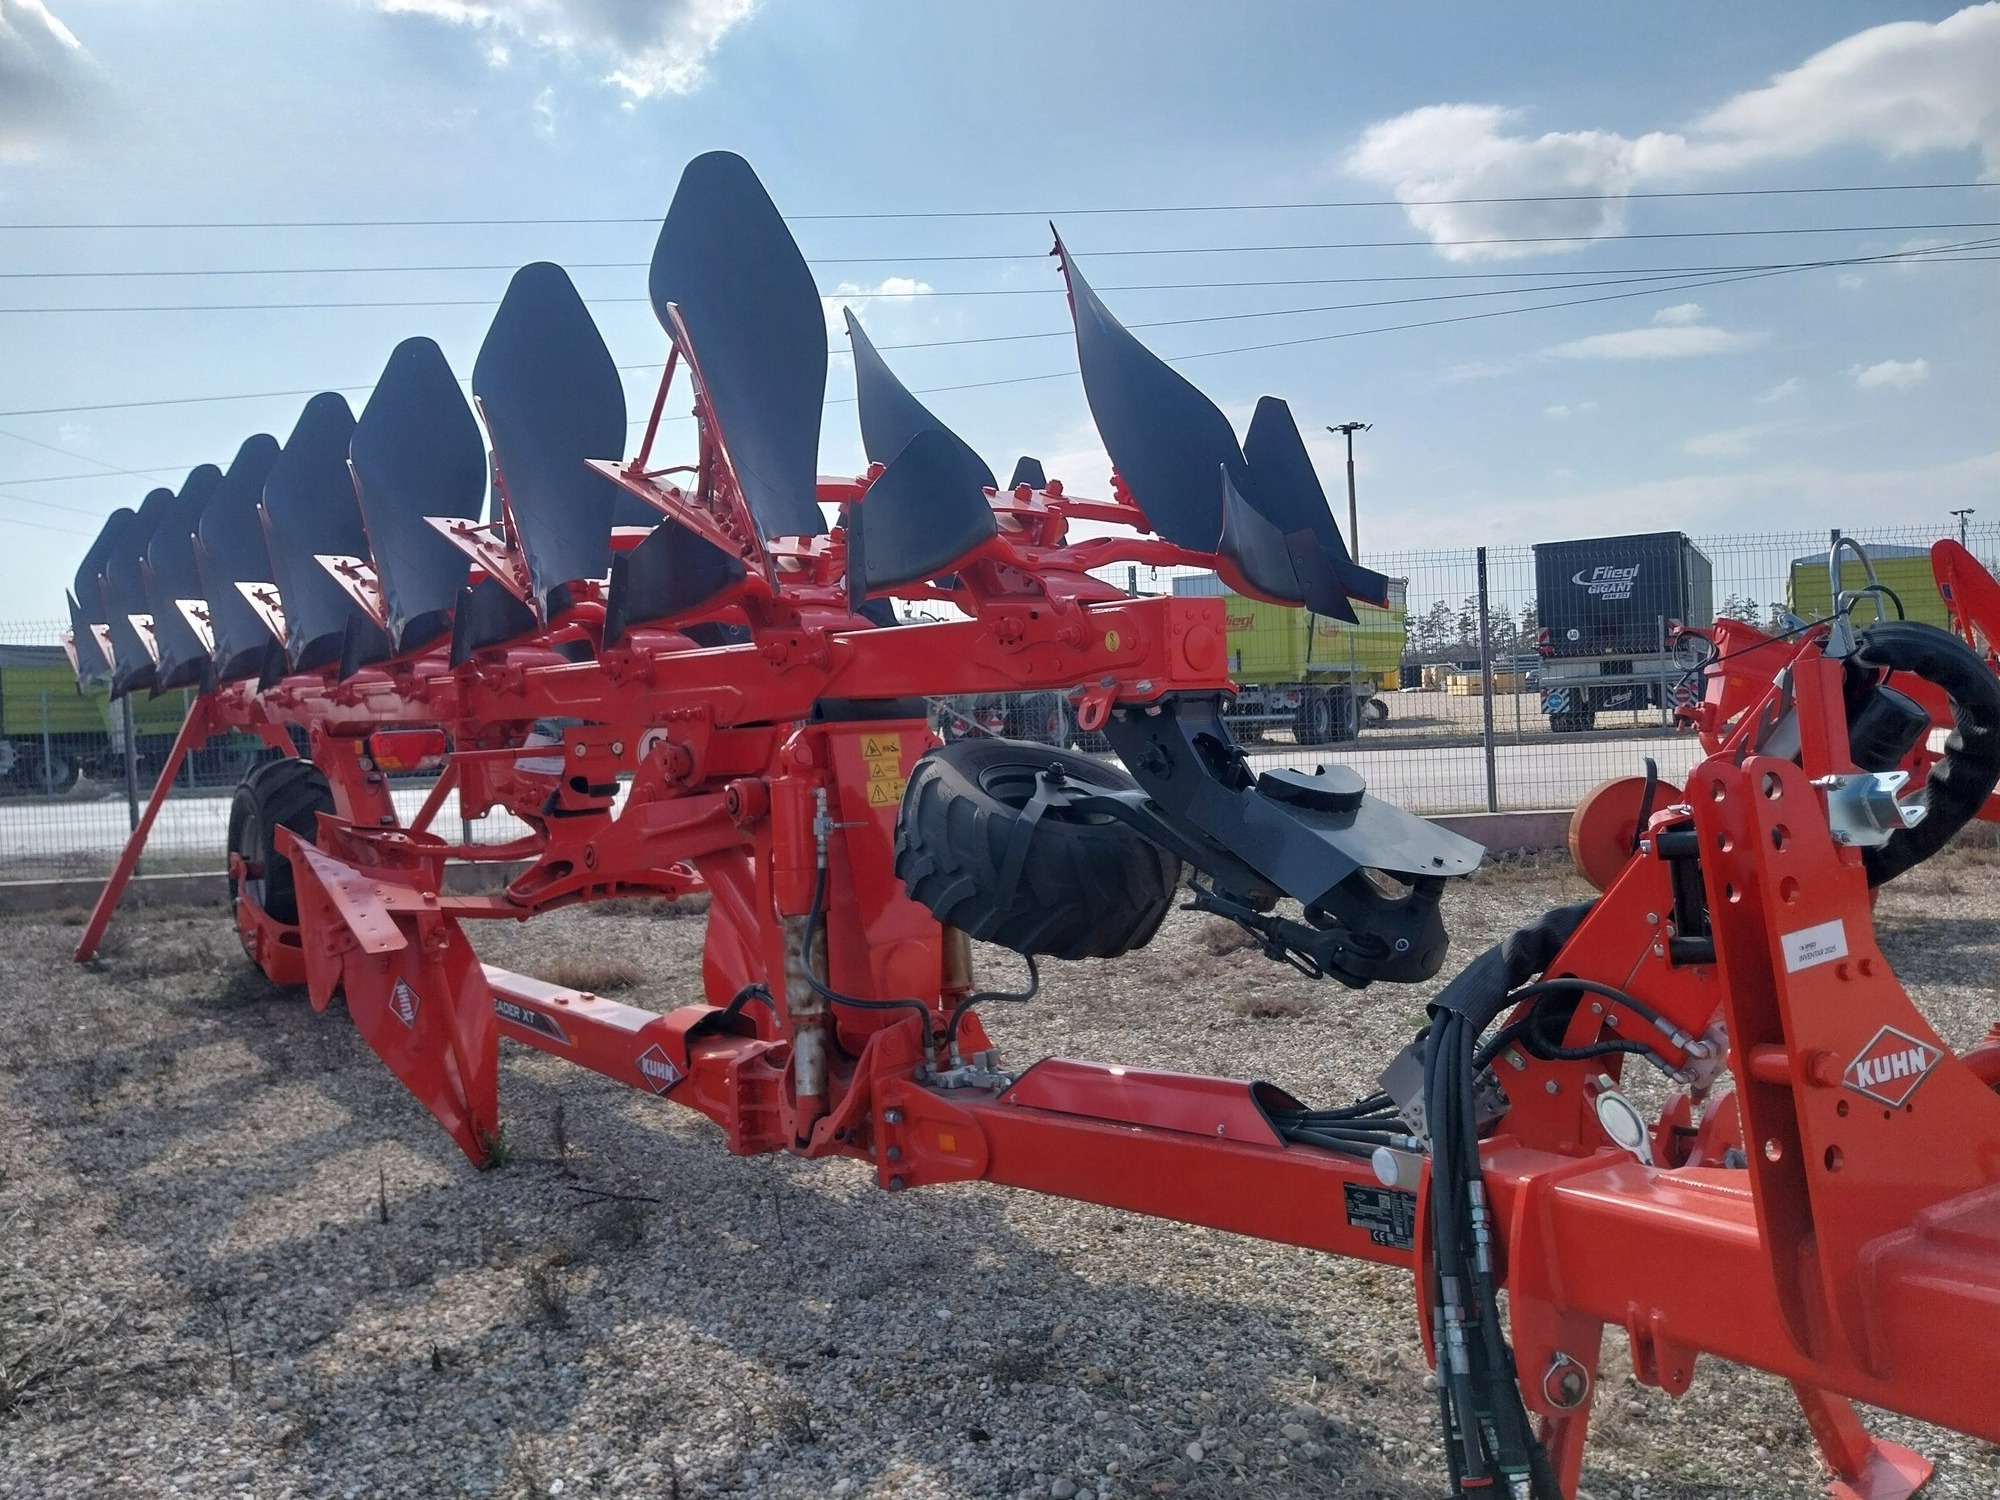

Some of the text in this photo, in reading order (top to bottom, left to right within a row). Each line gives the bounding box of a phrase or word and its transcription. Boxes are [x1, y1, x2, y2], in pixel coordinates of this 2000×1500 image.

[1592, 564, 1640, 581] Fliegl
[1588, 583, 1634, 594] GIGANT
[1226, 613, 1255, 628] liegl
[1799, 949, 1824, 962] INVENTAR
[395, 980, 414, 1021] KUHN
[494, 998, 535, 1023] EADER XT
[641, 1057, 675, 1082] KUHN
[1855, 1046, 1928, 1088] KUHN
